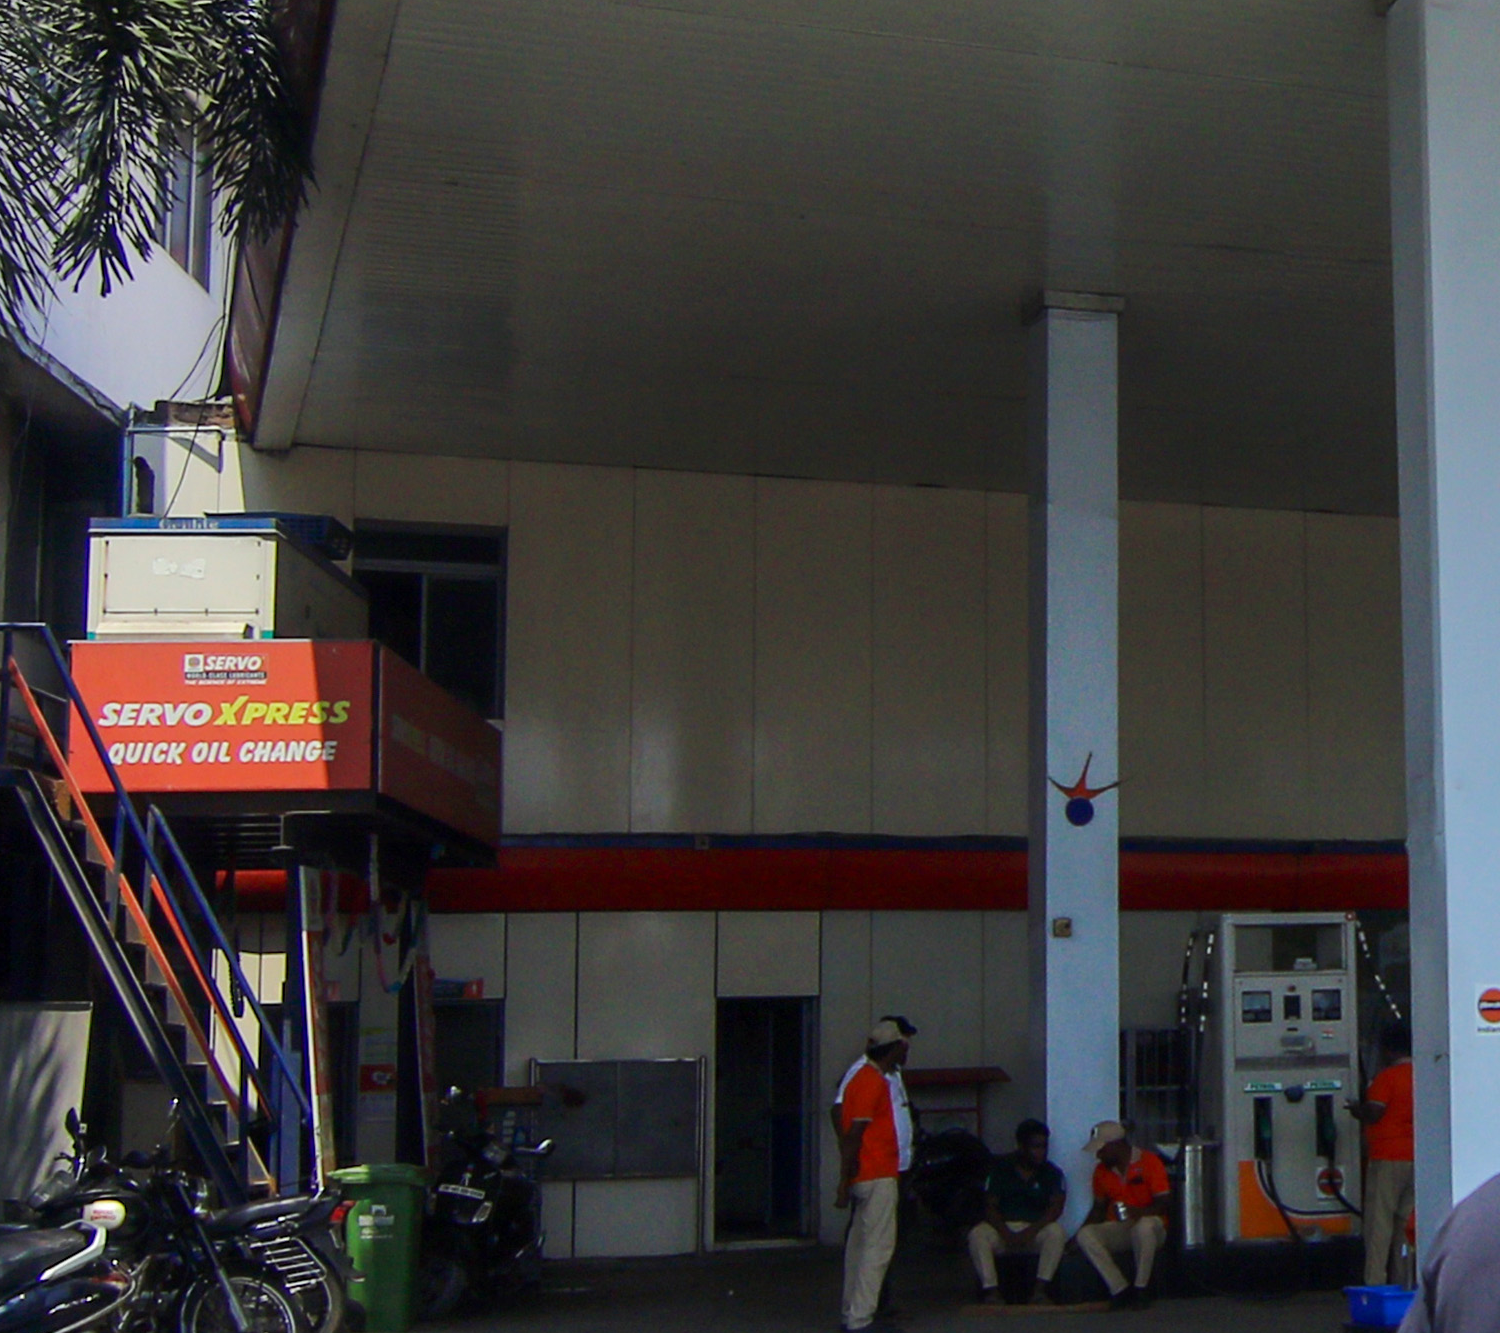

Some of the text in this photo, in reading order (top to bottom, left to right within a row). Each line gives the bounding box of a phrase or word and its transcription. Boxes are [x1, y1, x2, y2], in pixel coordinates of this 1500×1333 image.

[204, 655, 262, 671] SERVO
[98, 695, 351, 726] SERVO XPRESS
[108, 740, 338, 765] QUICK OIL CHANGE
